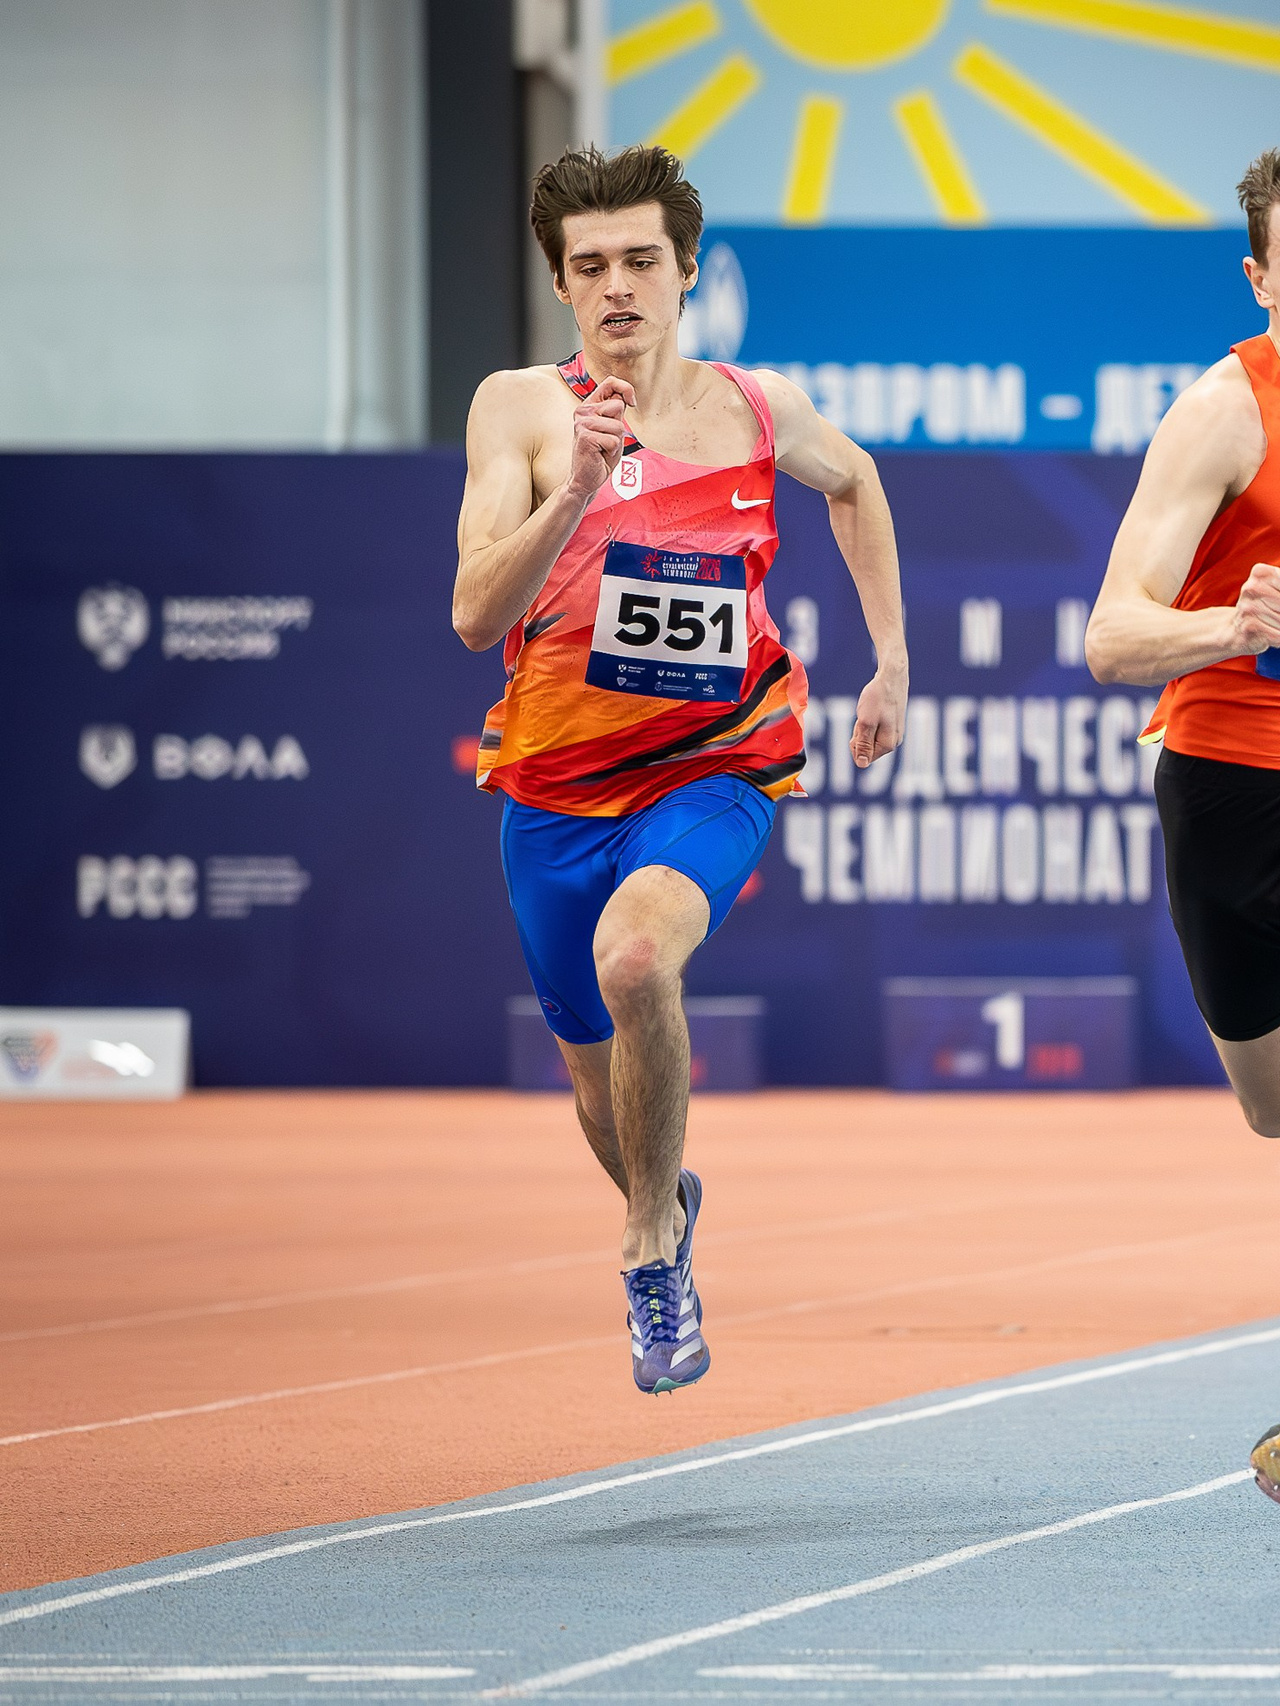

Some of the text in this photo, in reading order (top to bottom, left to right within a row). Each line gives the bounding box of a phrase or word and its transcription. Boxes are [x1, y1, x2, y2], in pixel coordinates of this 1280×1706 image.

[614, 592, 733, 654] 551
[783, 803, 1160, 904] ЧЕМПИОНАТ
[981, 990, 1026, 1071] 1
